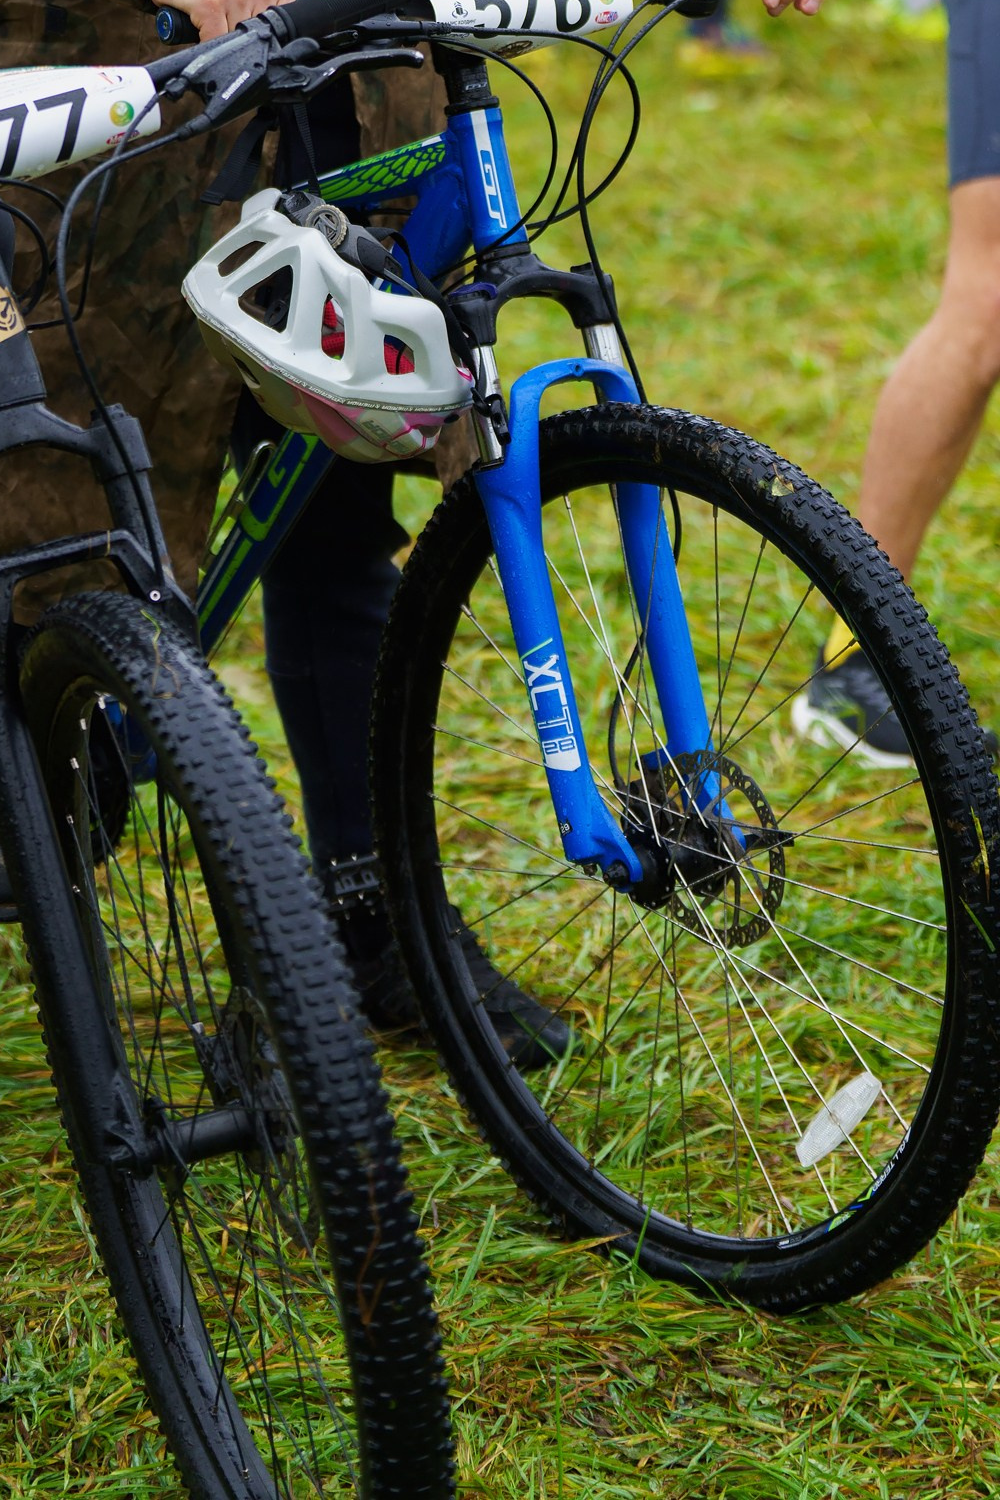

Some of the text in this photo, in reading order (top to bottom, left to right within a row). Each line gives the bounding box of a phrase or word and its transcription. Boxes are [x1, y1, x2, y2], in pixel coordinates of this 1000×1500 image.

[221, 70, 250, 101] SHIMANO
[480, 148, 507, 229] GT
[523, 653, 574, 736] XCT
